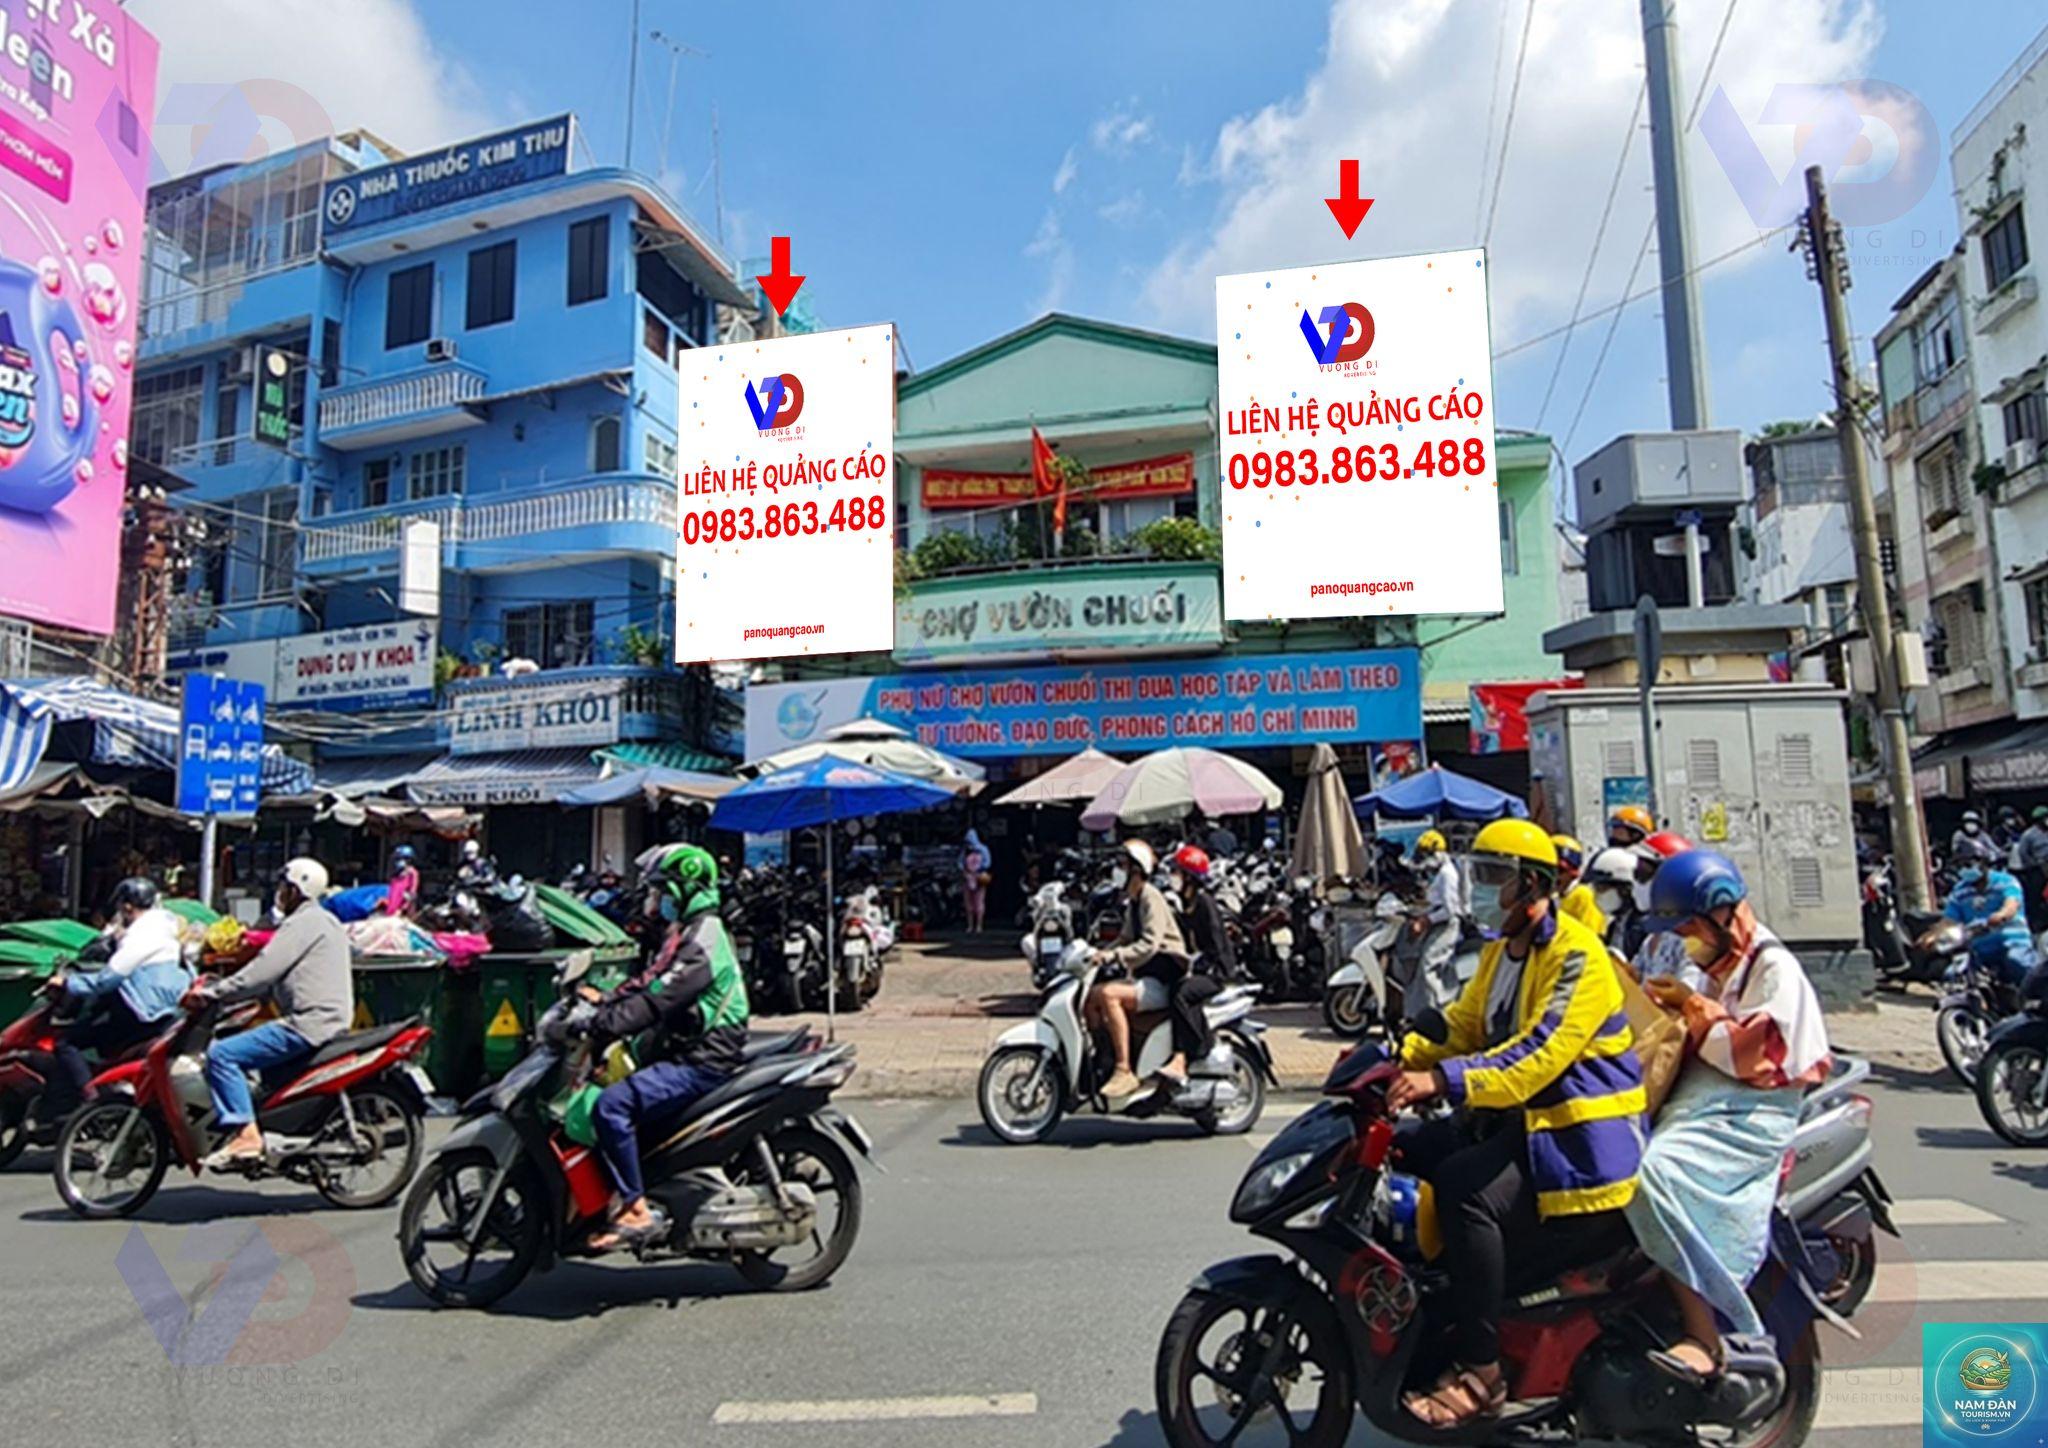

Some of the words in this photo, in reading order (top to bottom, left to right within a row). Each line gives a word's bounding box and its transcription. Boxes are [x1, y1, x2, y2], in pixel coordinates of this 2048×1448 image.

[70, 0, 115, 67] Xả
[359, 169, 398, 199] NHÀ
[405, 146, 470, 186] THUỐC
[477, 140, 516, 166] KIM
[523, 126, 565, 154] THU
[1227, 402, 1280, 436] LIÊN
[1287, 397, 1320, 437] HỆ
[1327, 389, 1421, 435] QUẢNG
[1428, 386, 1483, 421] CÁO
[684, 465, 726, 496] LIÊN
[732, 460, 758, 497] HỆ
[762, 453, 837, 495] QUẢNG
[842, 449, 886, 480] CÁO
[1228, 437, 1486, 490] 0983.863.488
[682, 494, 886, 546] 0983.863.488
[921, 601, 978, 640] CHỢ
[988, 591, 1072, 632] VƯỜN
[1083, 581, 1186, 627] CHUỐI
[1310, 579, 1414, 598] panoquangcao.vn
[362, 651, 371, 669] Y
[376, 644, 414, 669] KHOA
[743, 623, 825, 642] panoquangcao.vn
[456, 704, 523, 734] LINH
[534, 691, 611, 729] KHÔI
[879, 689, 914, 716] PHỤ
[919, 683, 946, 709] NỮ
[949, 682, 985, 713] CHỢ
[989, 677, 1037, 706] VƯỜN
[1041, 671, 1098, 703] CHUỐI
[1103, 678, 1132, 700] THI
[1138, 673, 1175, 700] ĐUA
[1180, 672, 1219, 701] HỌC
[1225, 667, 1262, 700] TẬP
[1267, 665, 1294, 694] VÀ
[1297, 664, 1343, 694] LÀM
[1348, 664, 1400, 690] THEO
[916, 722, 940, 746] TƯ
[1011, 720, 1049, 749] ĐẠO
[1101, 714, 1167, 740] PHONG
[1173, 706, 1224, 737] CÁCH
[1230, 704, 1257, 734] HỒ
[1262, 705, 1297, 734] CHÍ
[1302, 706, 1357, 732] MINH
